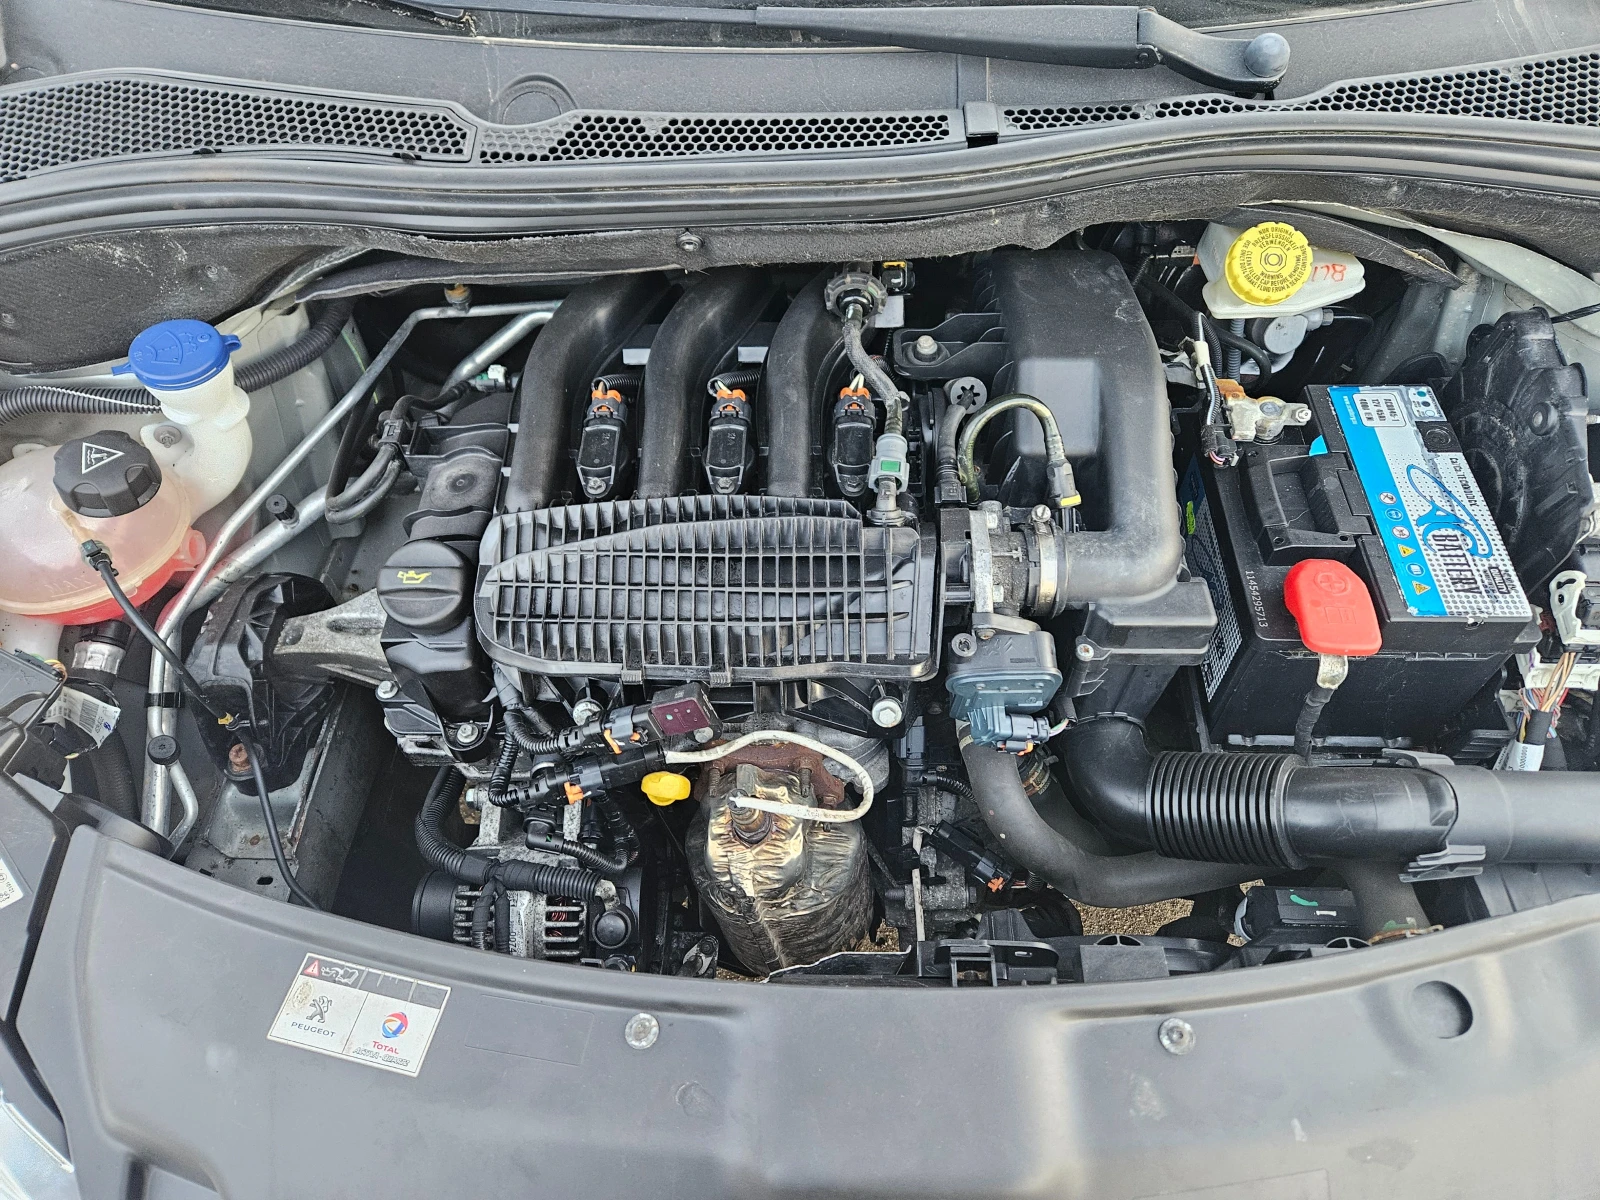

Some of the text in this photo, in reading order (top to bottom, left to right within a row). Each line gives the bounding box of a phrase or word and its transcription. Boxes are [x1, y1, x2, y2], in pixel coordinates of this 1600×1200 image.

[1271, 227, 1294, 238] ORIGINAL
[1243, 240, 1251, 249] USE
[1259, 239, 1291, 251] VERWENDEN
[1248, 267, 1261, 281] FILLER
[1271, 277, 1288, 286] BEFORE
[1288, 255, 1301, 279] REMOVING
[1260, 271, 1283, 279] WARNING
[1312, 264, 1346, 282] 178
[1244, 274, 1257, 287] BRAKE
[1272, 284, 1286, 293] FROM
[1372, 399, 1381, 407] 12V
[1432, 534, 1482, 595] BATTERY
[1490, 568, 1509, 593] QUALITY
[1245, 570, 1268, 628] 11454295713
[291, 1021, 336, 1038] PEUGEOT
[373, 1041, 399, 1055] TOTAL
